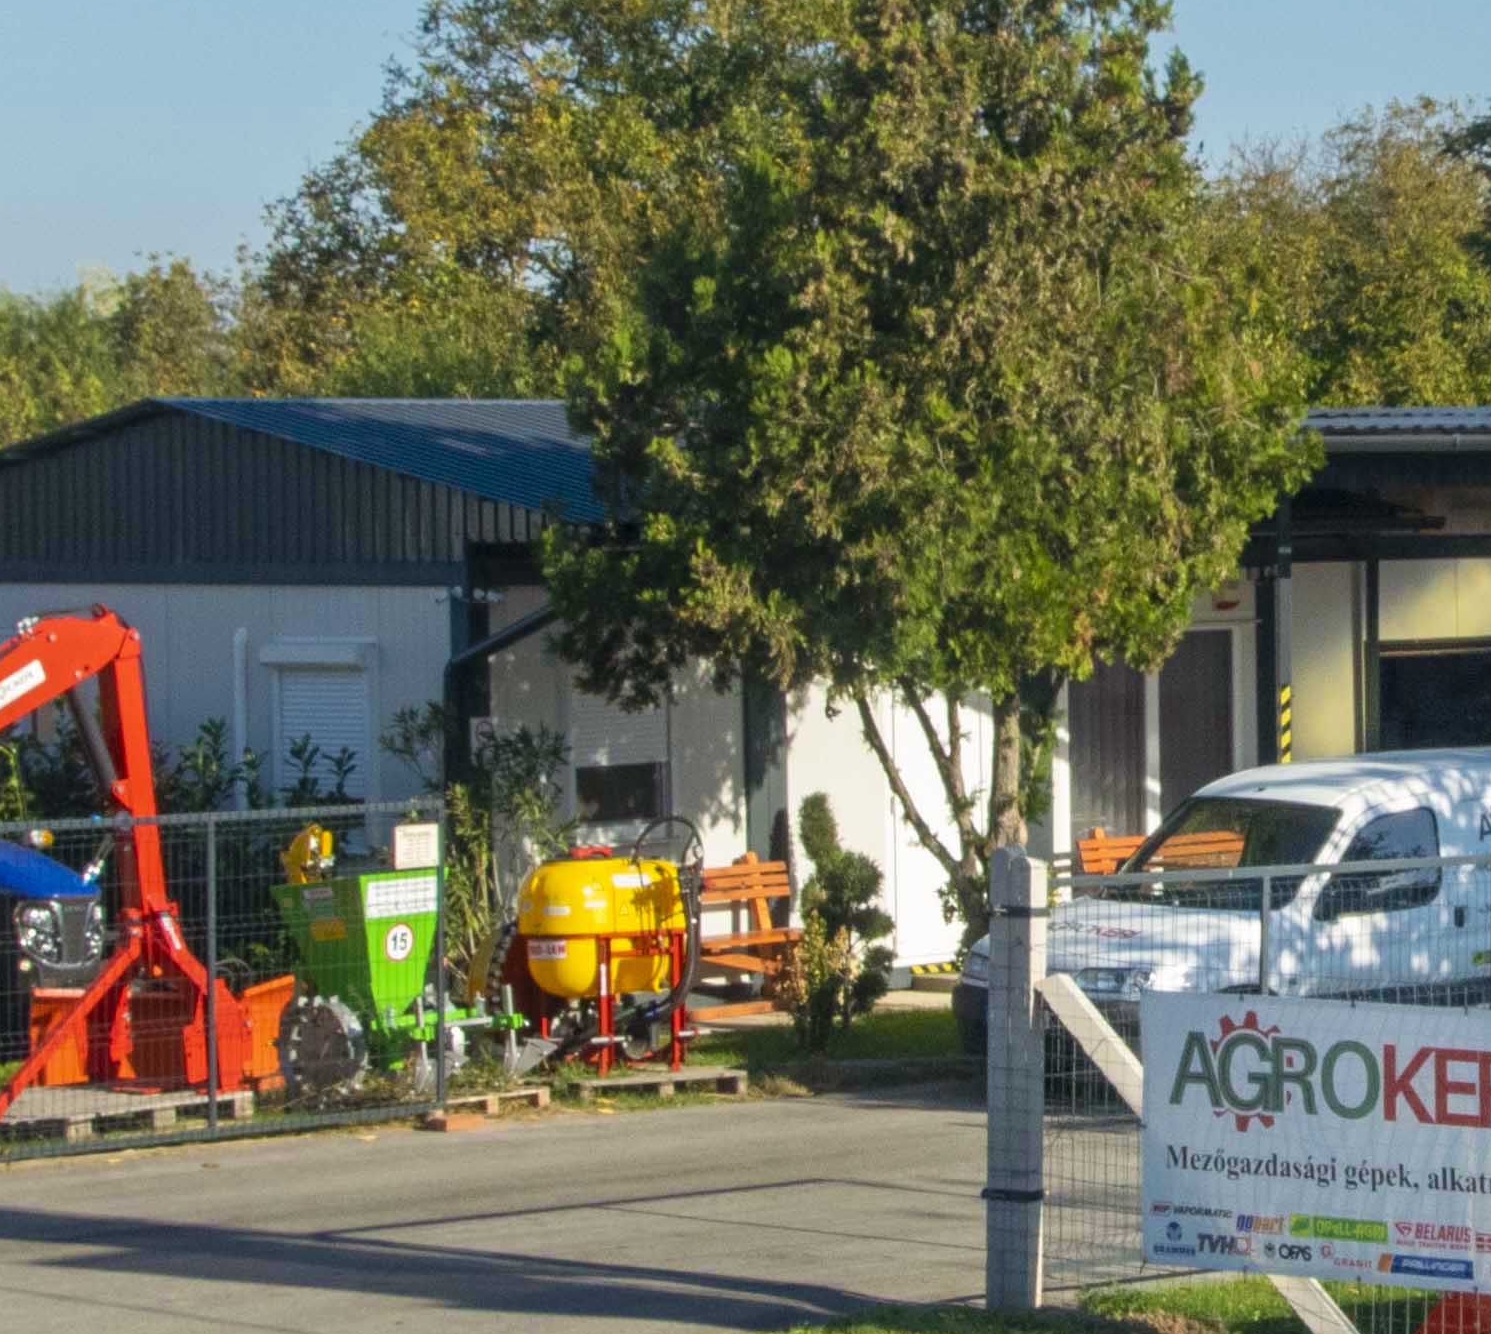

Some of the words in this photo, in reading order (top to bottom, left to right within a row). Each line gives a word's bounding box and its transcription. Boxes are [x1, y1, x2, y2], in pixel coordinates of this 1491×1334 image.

[391, 931, 408, 952] 15
[1165, 1143, 1337, 1187] Mezőgazdasági
[1344, 1157, 1421, 1194] gépek,
[1414, 1222, 1473, 1244] BELARUS
